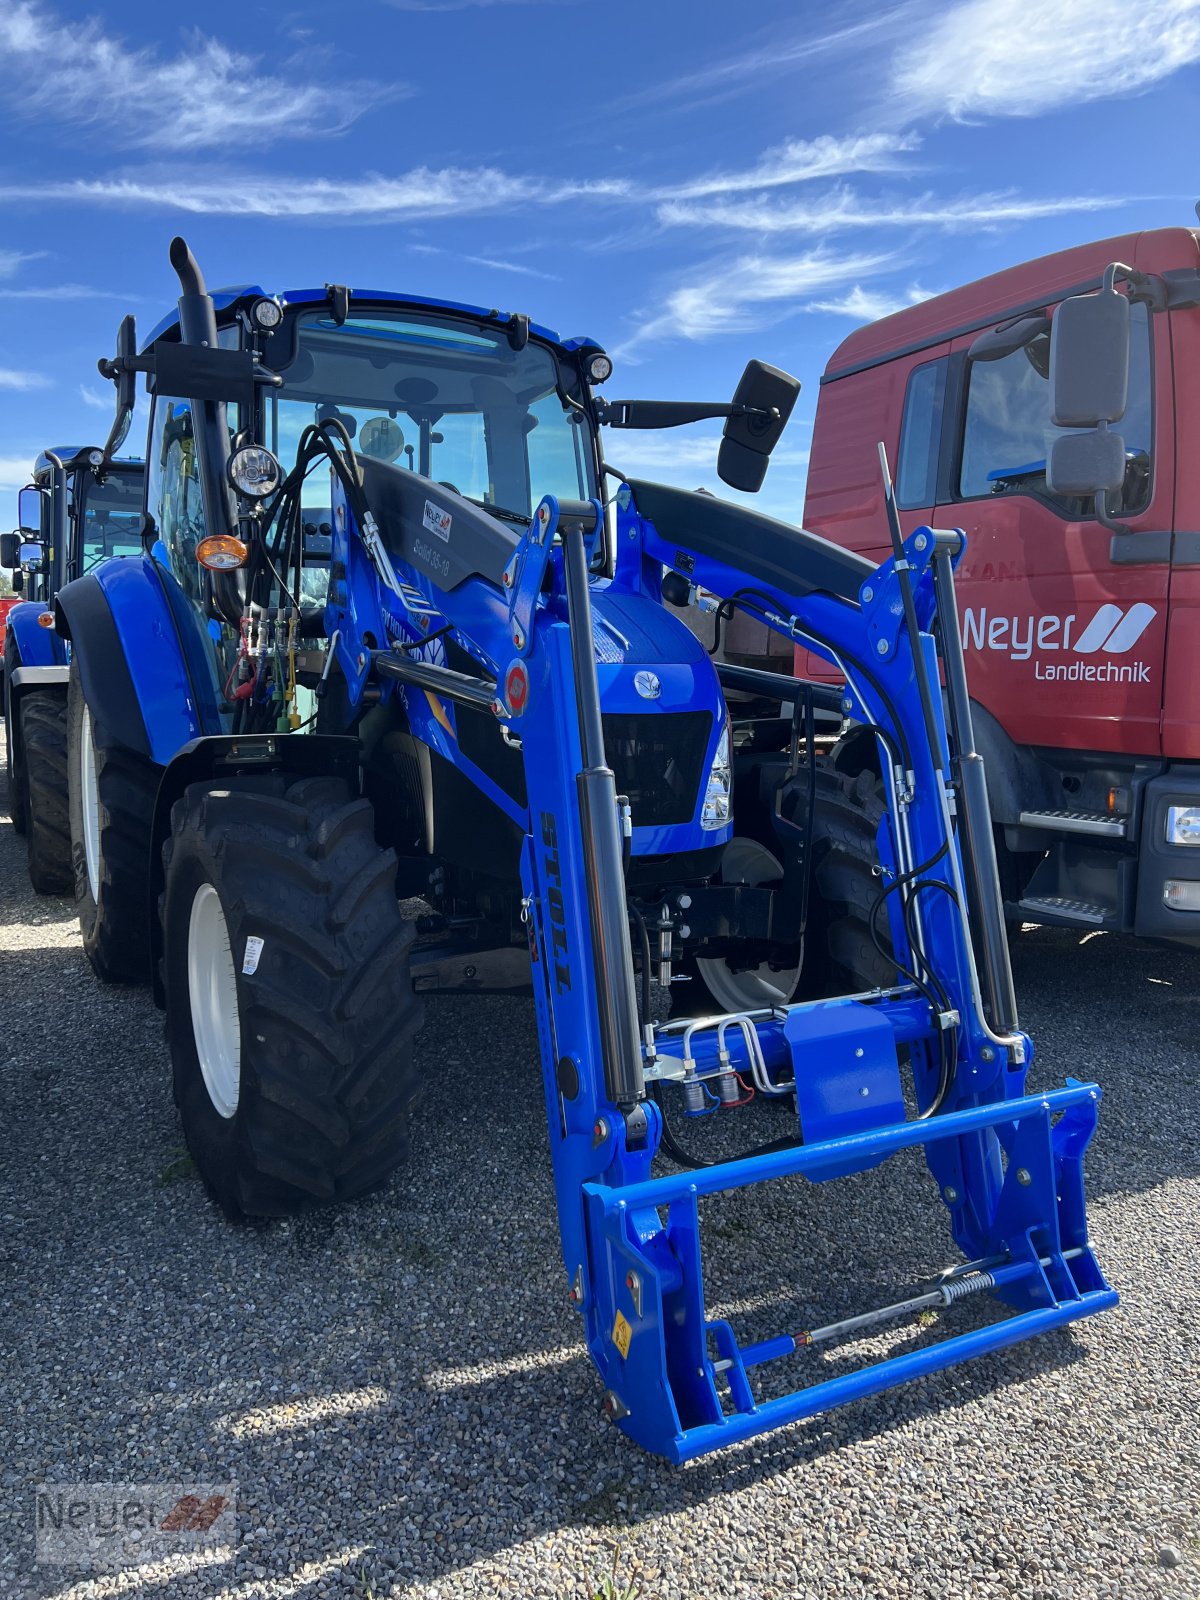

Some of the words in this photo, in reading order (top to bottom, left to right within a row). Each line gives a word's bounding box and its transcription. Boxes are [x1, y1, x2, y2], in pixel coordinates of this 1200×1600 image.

[413, 539, 432, 560] Solid
[430, 551, 450, 577] 35-18
[962, 607, 1076, 660] Neyer
[1034, 660, 1152, 683] Landtechnik
[540, 811, 572, 996] STOLL
